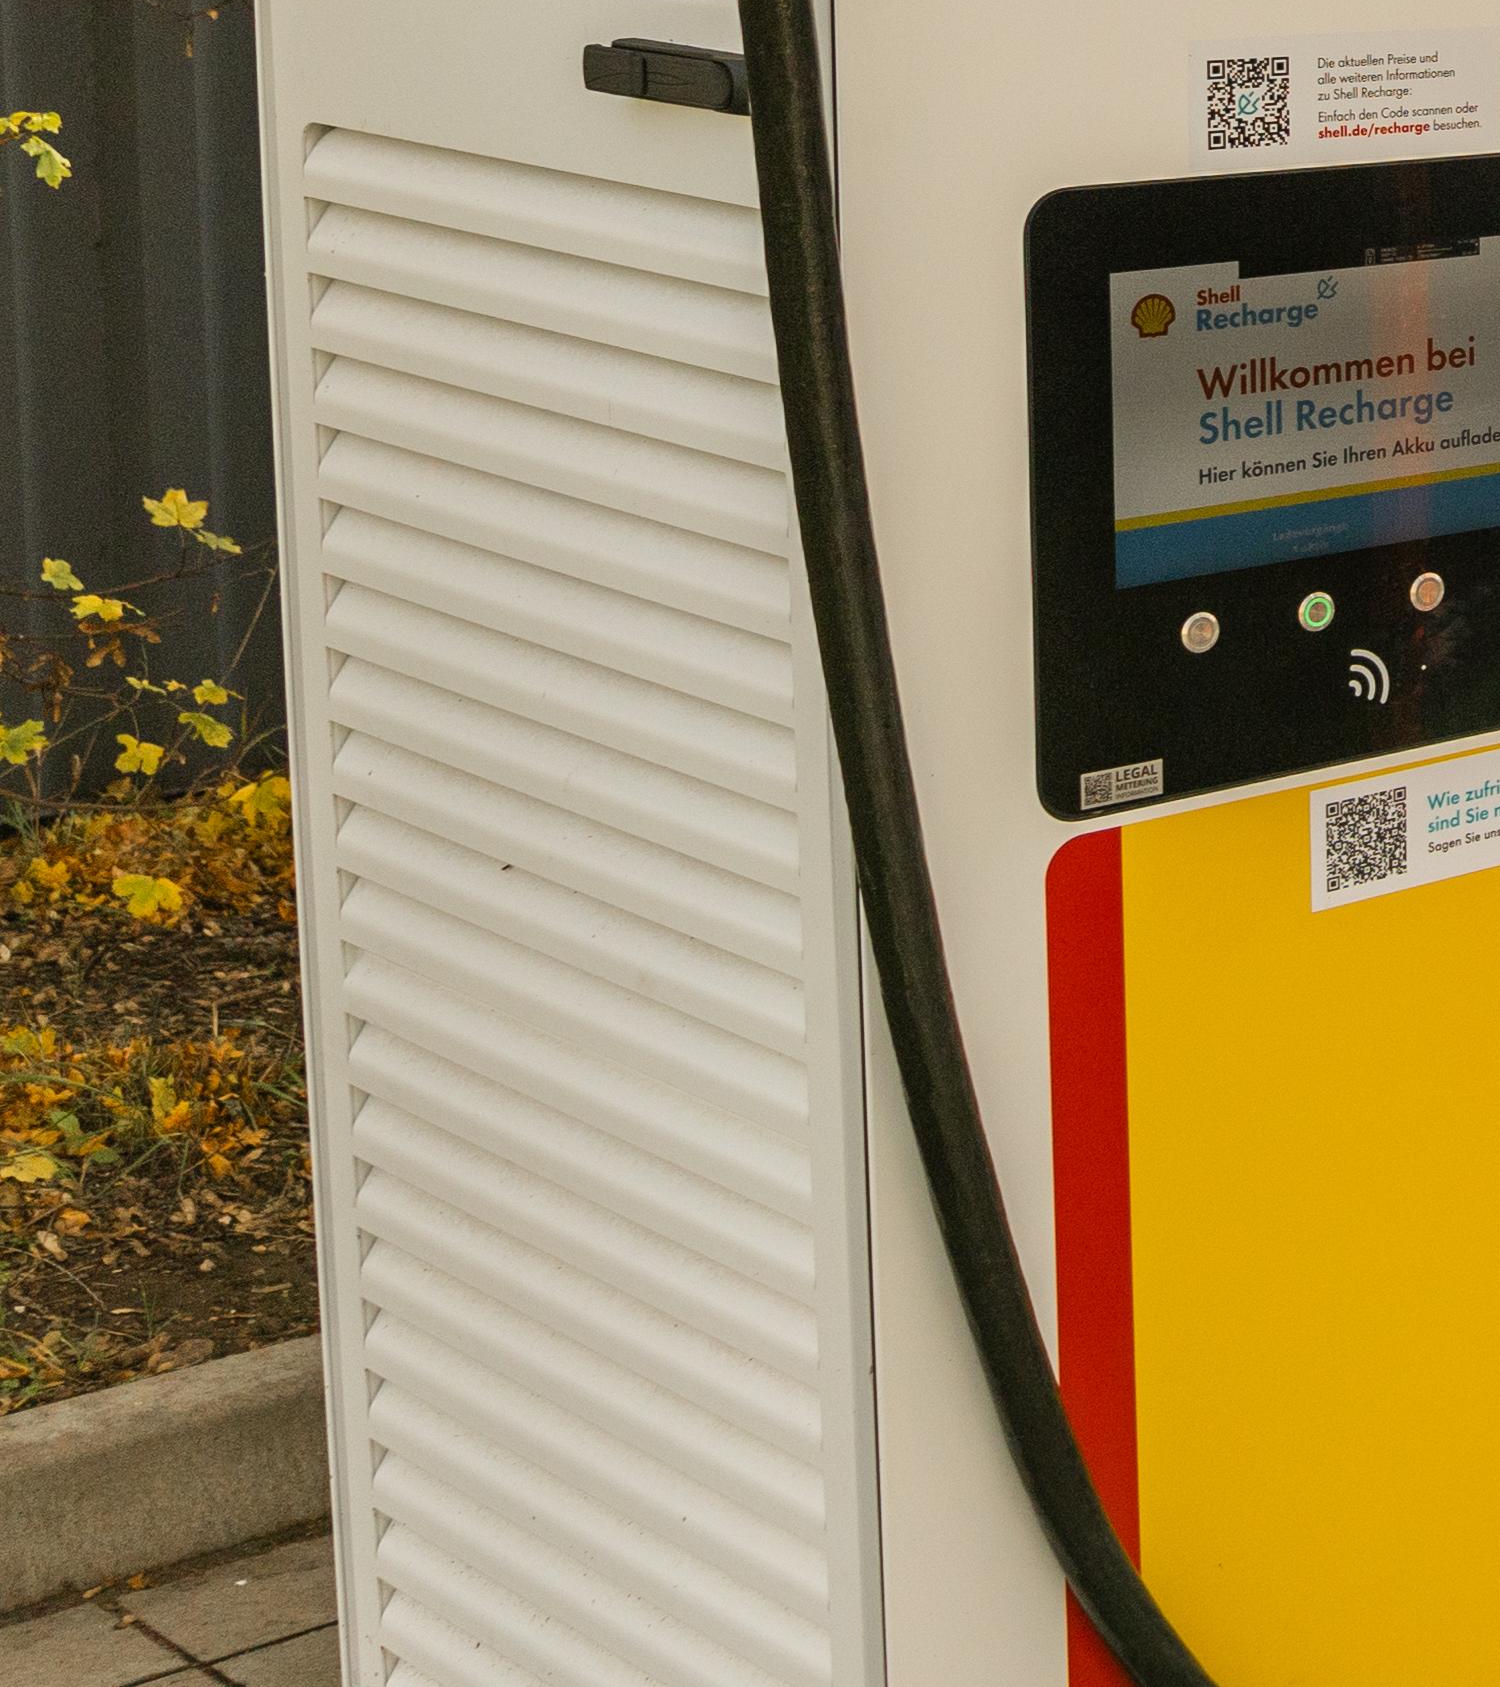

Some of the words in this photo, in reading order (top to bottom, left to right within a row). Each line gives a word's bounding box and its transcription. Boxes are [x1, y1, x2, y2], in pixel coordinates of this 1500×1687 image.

[1317, 57, 1335, 69] Die
[1338, 55, 1385, 68] aktuellen
[1387, 53, 1417, 65] Preise
[1420, 51, 1439, 63] und
[1318, 73, 1337, 85] alle
[1339, 70, 1383, 83] weiteren
[1386, 68, 1455, 81] Informationen
[1318, 92, 1330, 102] zu
[1333, 88, 1358, 100] Shell
[1361, 86, 1413, 99] Recharge:
[1318, 110, 1356, 123] Einfach
[1358, 108, 1378, 121] den
[1381, 106, 1409, 119] Code
[1412, 105, 1453, 117] scannen
[1455, 102, 1479, 114] oder
[1318, 122, 1430, 140] shell.de/recharge
[1433, 118, 1483, 132] besuchen.
[1196, 285, 1241, 306] Shell
[1196, 303, 1319, 332] Recharge
[1196, 352, 1414, 401] Willkommen
[1427, 336, 1476, 371] bei
[1199, 399, 1283, 445] Shell
[1296, 389, 1454, 432] Recharge
[1199, 467, 1236, 485] Hier
[1241, 460, 1306, 480] können
[1312, 452, 1338, 468] Sie
[1343, 445, 1387, 464] Ihren
[1392, 437, 1435, 457] Akku
[1116, 764, 1158, 783] LEGAL
[1116, 777, 1159, 791] METERING
[1427, 790, 1460, 810] Wie
[1428, 810, 1460, 833] sind
[1466, 806, 1489, 824] Sie
[1428, 836, 1462, 854] Sagen
[1465, 833, 1481, 844] Sie
[1484, 828, 1500, 840] uns
